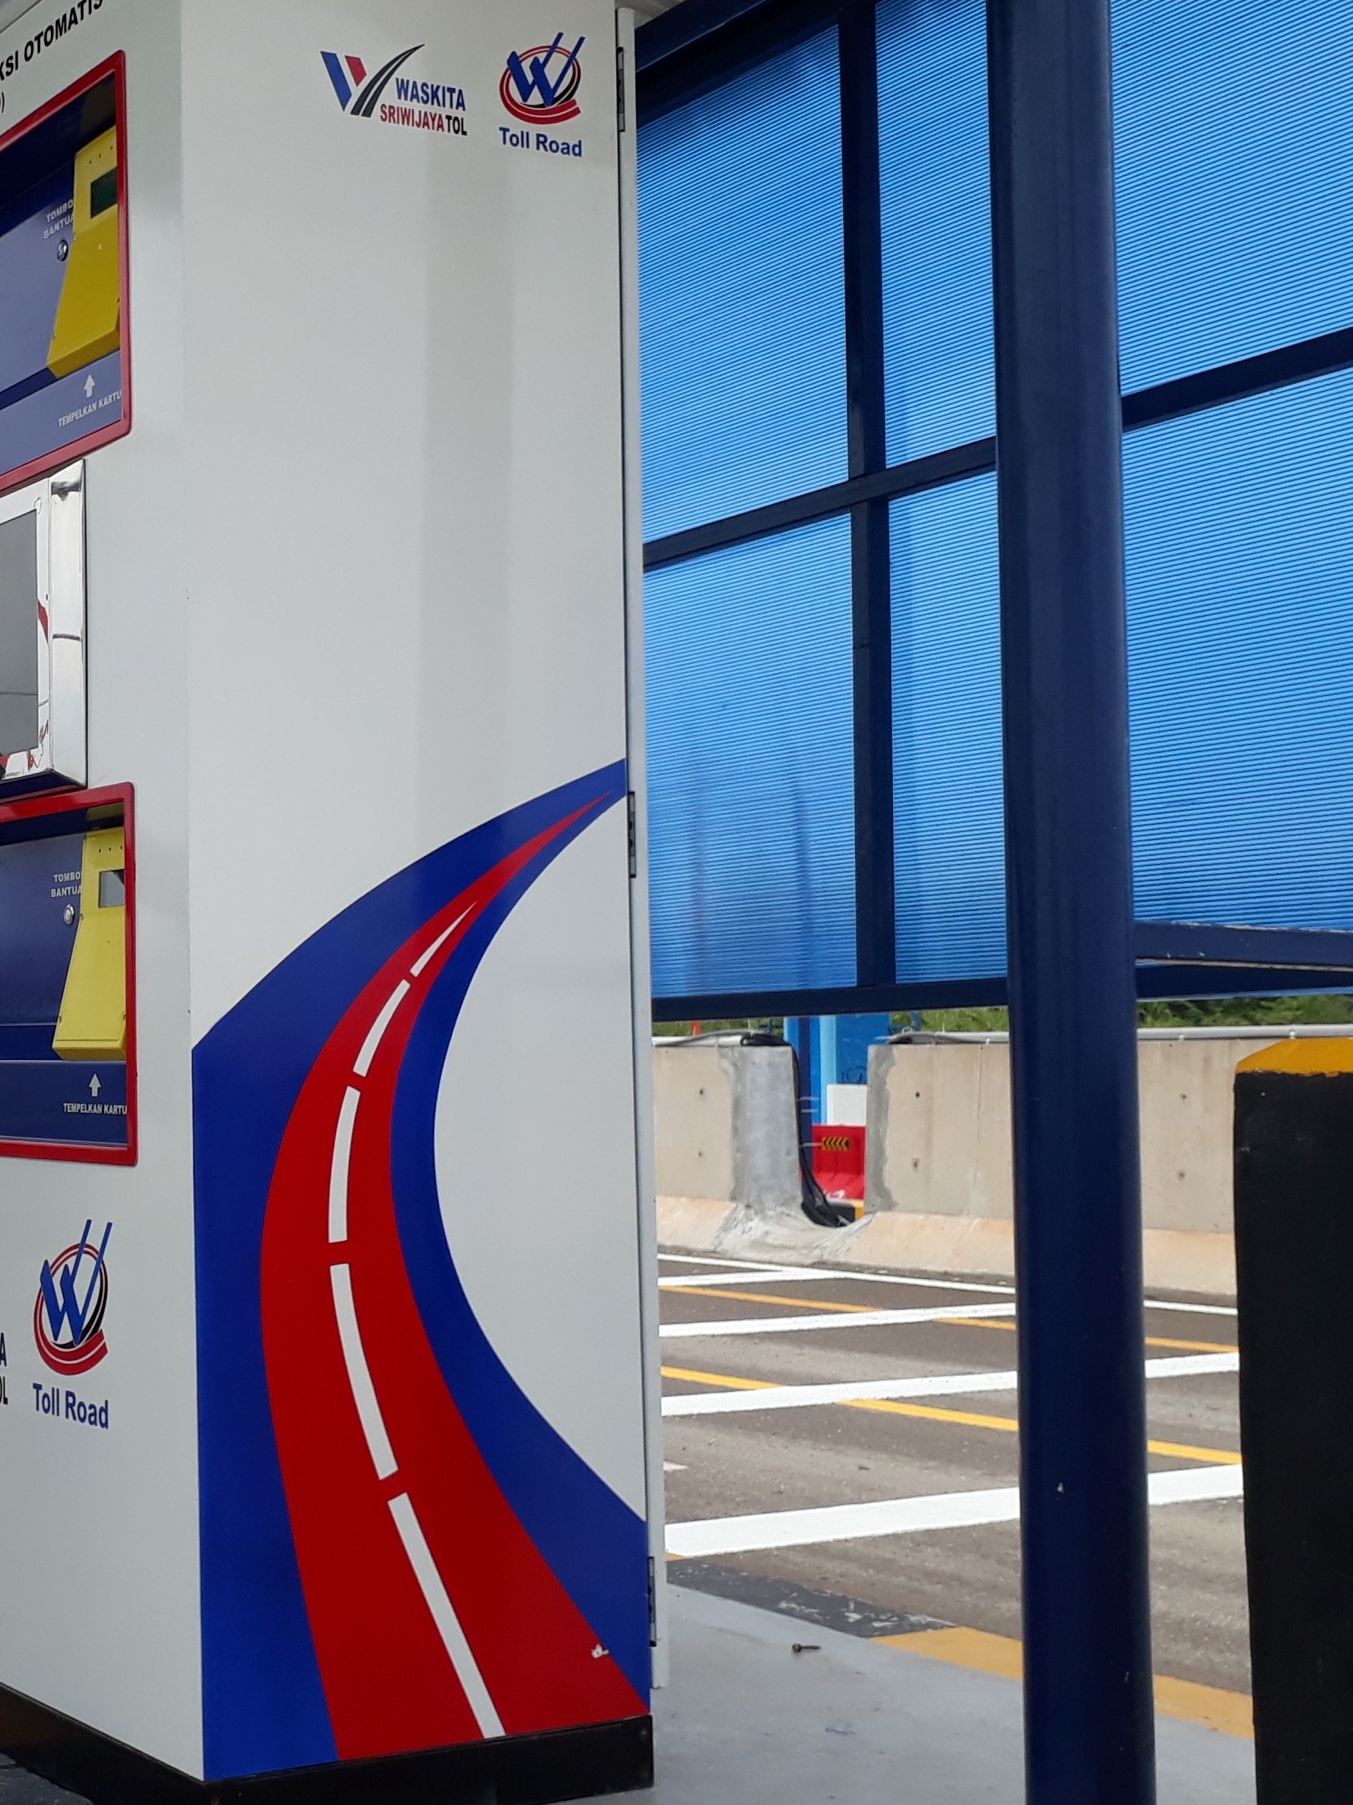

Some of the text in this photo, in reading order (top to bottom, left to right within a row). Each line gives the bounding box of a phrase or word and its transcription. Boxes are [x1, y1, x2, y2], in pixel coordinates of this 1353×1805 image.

[395, 77, 466, 112] WASKITA
[499, 126, 583, 158] Toll Road
[46, 199, 74, 223] TOMBO
[58, 389, 122, 428] TEMPELKAN KARTU
[53, 871, 82, 883] TOMBO
[50, 885, 82, 898] BANTUA
[63, 1102, 128, 1115] TEMPELKAN KARTU
[32, 1382, 109, 1429] Toll Road
